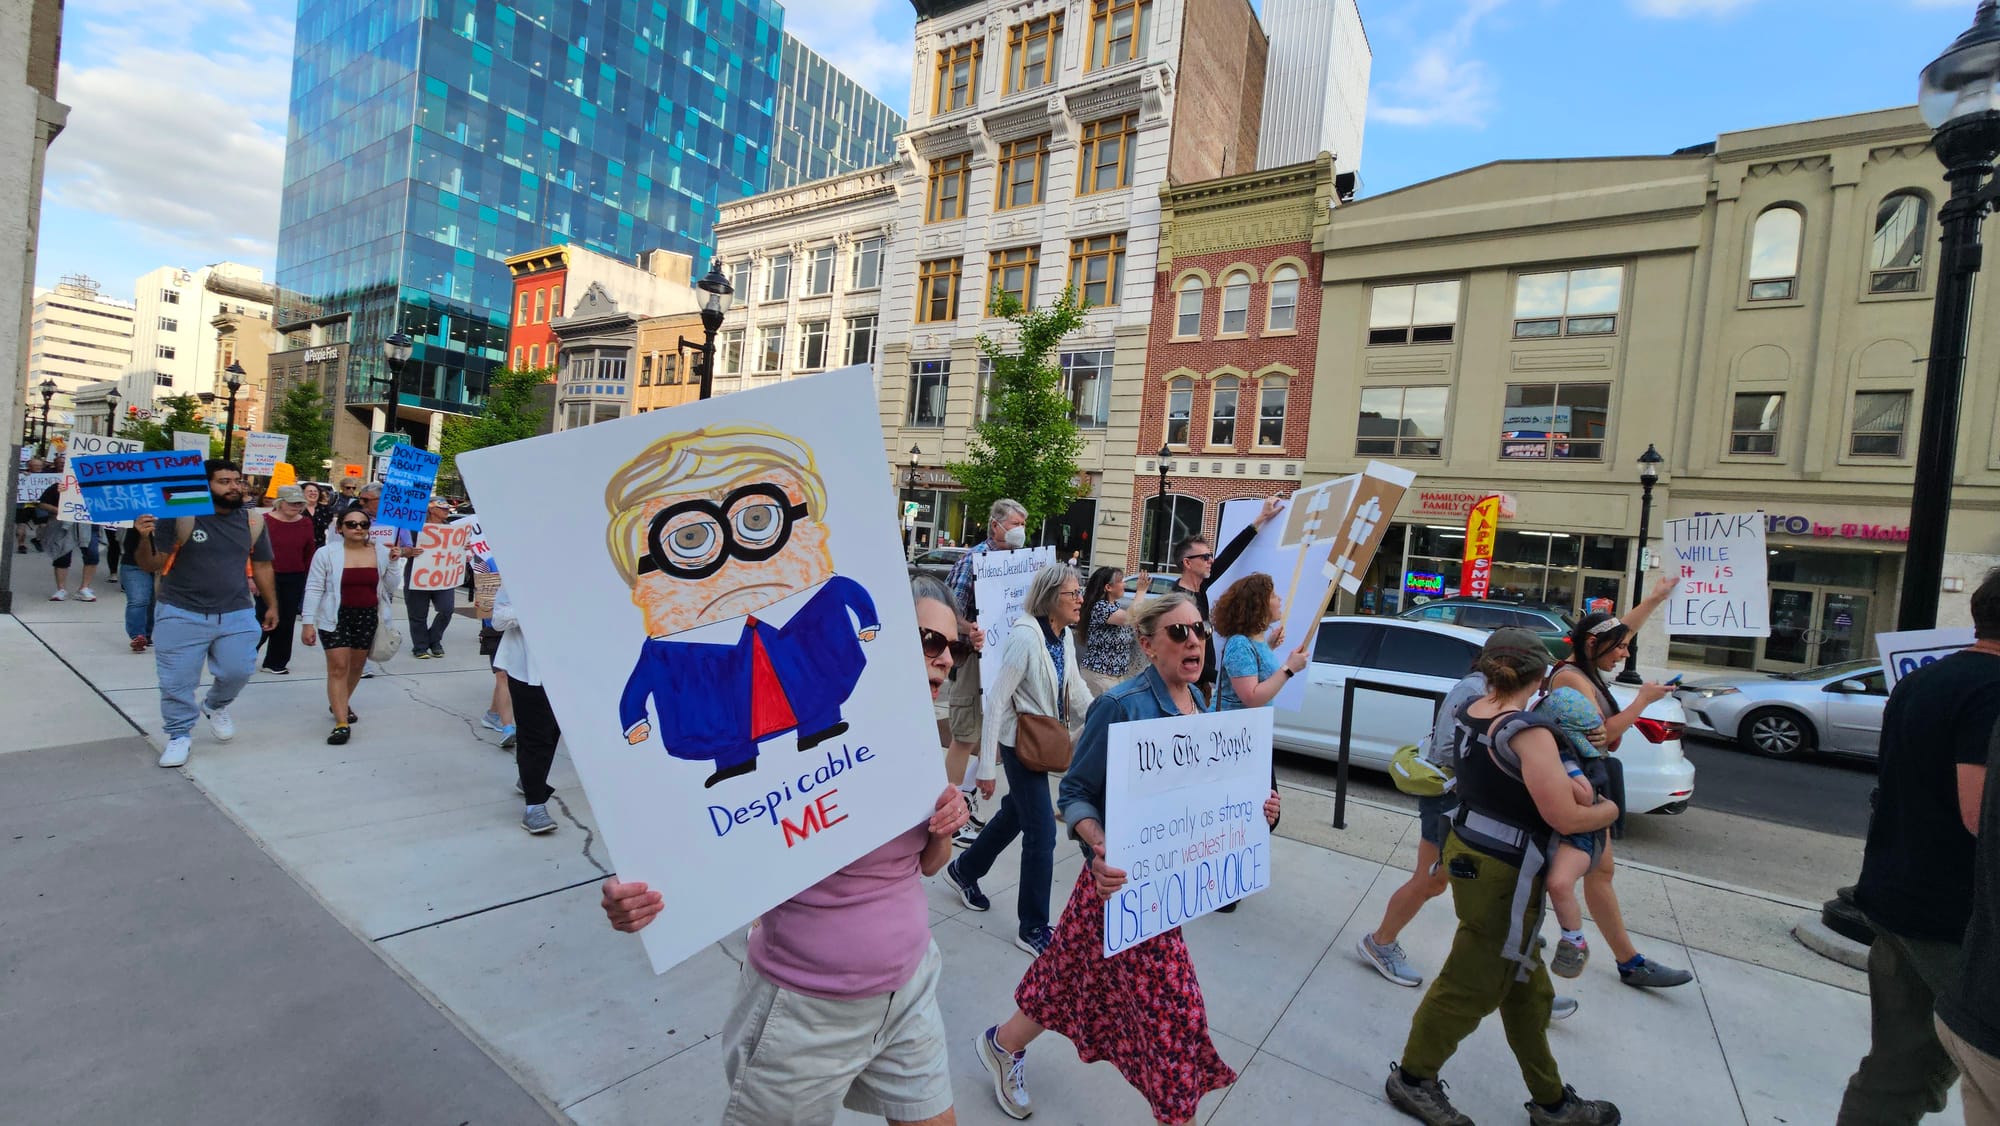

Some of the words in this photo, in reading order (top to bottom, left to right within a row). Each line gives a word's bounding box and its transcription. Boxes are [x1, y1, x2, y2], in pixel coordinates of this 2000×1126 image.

[73, 437, 101, 452] NO
[107, 440, 138, 454] ONE
[393, 446, 422, 461] DON'T
[423, 454, 442, 465] TALK
[80, 460, 145, 477] DEPORT
[150, 454, 202, 471] TRUMP
[391, 459, 424, 472] ABOUT
[102, 484, 157, 500] FREE
[386, 482, 402, 495] YOU
[403, 487, 426, 500] VOTED
[414, 480, 432, 491] WHEN
[85, 496, 160, 512] PALESTINE
[384, 493, 401, 504] FOR
[1420, 492, 1475, 502] HAMILTON
[1423, 501, 1459, 510] FAMILY
[383, 503, 426, 522] RAPIST
[420, 524, 472, 549] STOP
[1475, 503, 1492, 556] VAPE
[1666, 514, 1756, 543] THINK
[1812, 521, 1836, 538] by
[1860, 523, 1911, 541] Mobi
[432, 551, 461, 566] the
[1675, 546, 1729, 561] WHILE
[413, 565, 464, 588] COUP
[977, 560, 1002, 580] Hideous
[1471, 558, 1490, 598] SMOK
[1680, 565, 1695, 577] it
[1714, 564, 1734, 578] is
[1685, 581, 1729, 594] STILL
[1668, 599, 1760, 630] LEGAL
[1137, 738, 1163, 777] We
[1172, 732, 1200, 770] The
[1207, 727, 1252, 767] People
[708, 744, 876, 837] Despicable
[780, 788, 849, 849] ME
[1140, 823, 1165, 845] are
[1169, 806, 1196, 840] only
[1201, 809, 1214, 828] as
[1219, 794, 1253, 822] strong
[1132, 859, 1150, 881] as
[1155, 850, 1178, 872] our
[1182, 830, 1226, 865] weakest
[1229, 819, 1247, 849] link
[1106, 881, 1153, 952] USE
[1155, 861, 1213, 930] YOUR
[1216, 843, 1264, 903] VOICE
